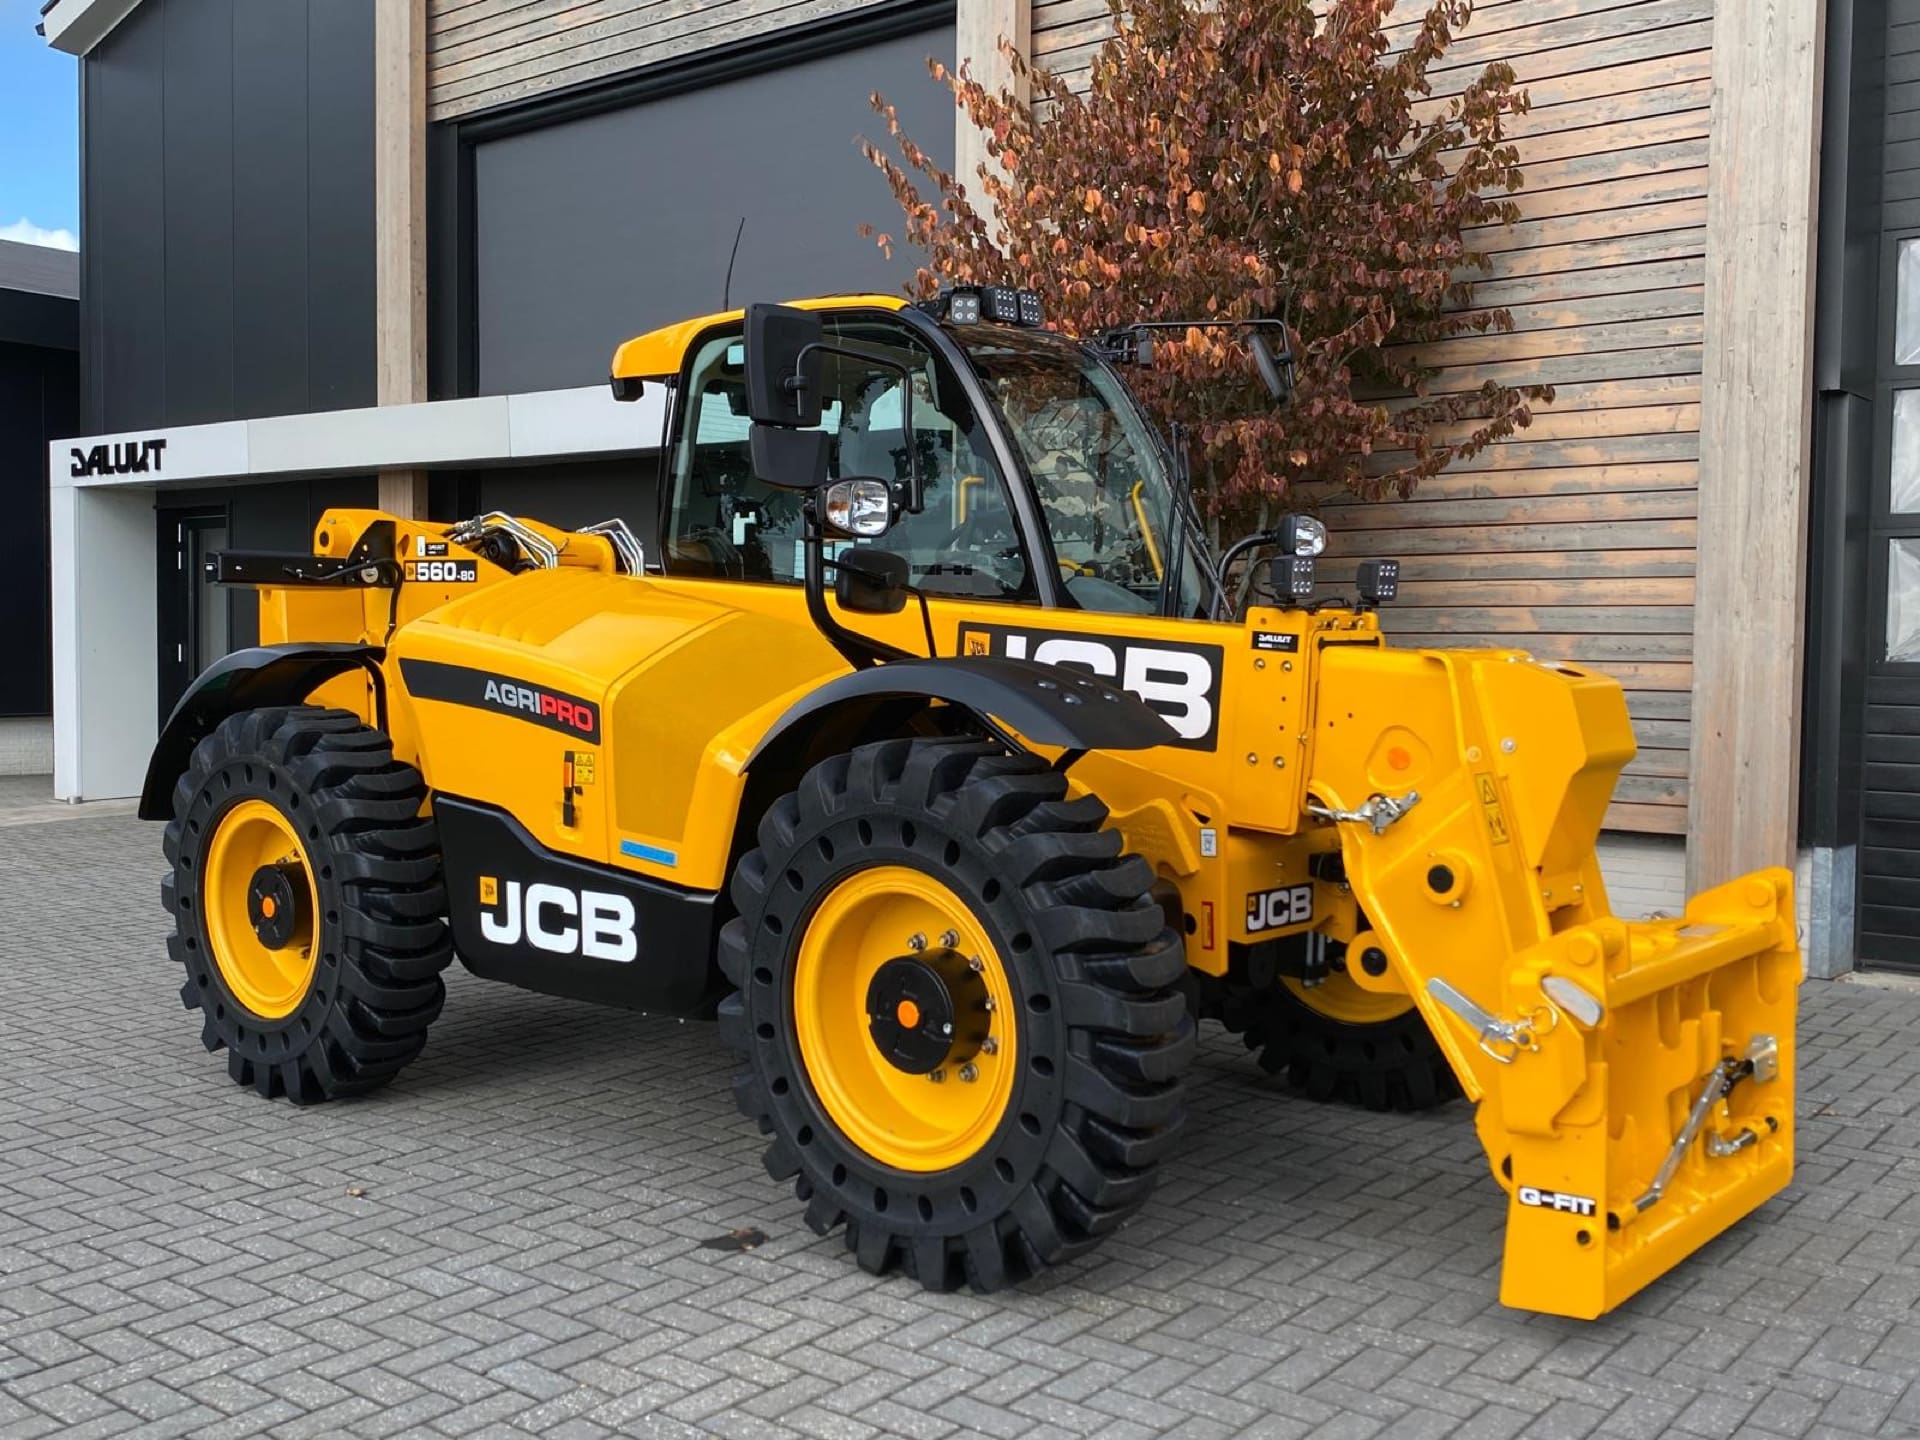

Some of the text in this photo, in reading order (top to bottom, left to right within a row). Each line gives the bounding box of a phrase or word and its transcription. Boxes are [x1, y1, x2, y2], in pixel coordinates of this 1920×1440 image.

[417, 562, 475, 582] 560-80
[484, 679, 593, 733] AGRIPRO
[480, 880, 637, 963] JCB
[1247, 886, 1312, 931] JCB
[1519, 1186, 1596, 1216] Q-FIT
